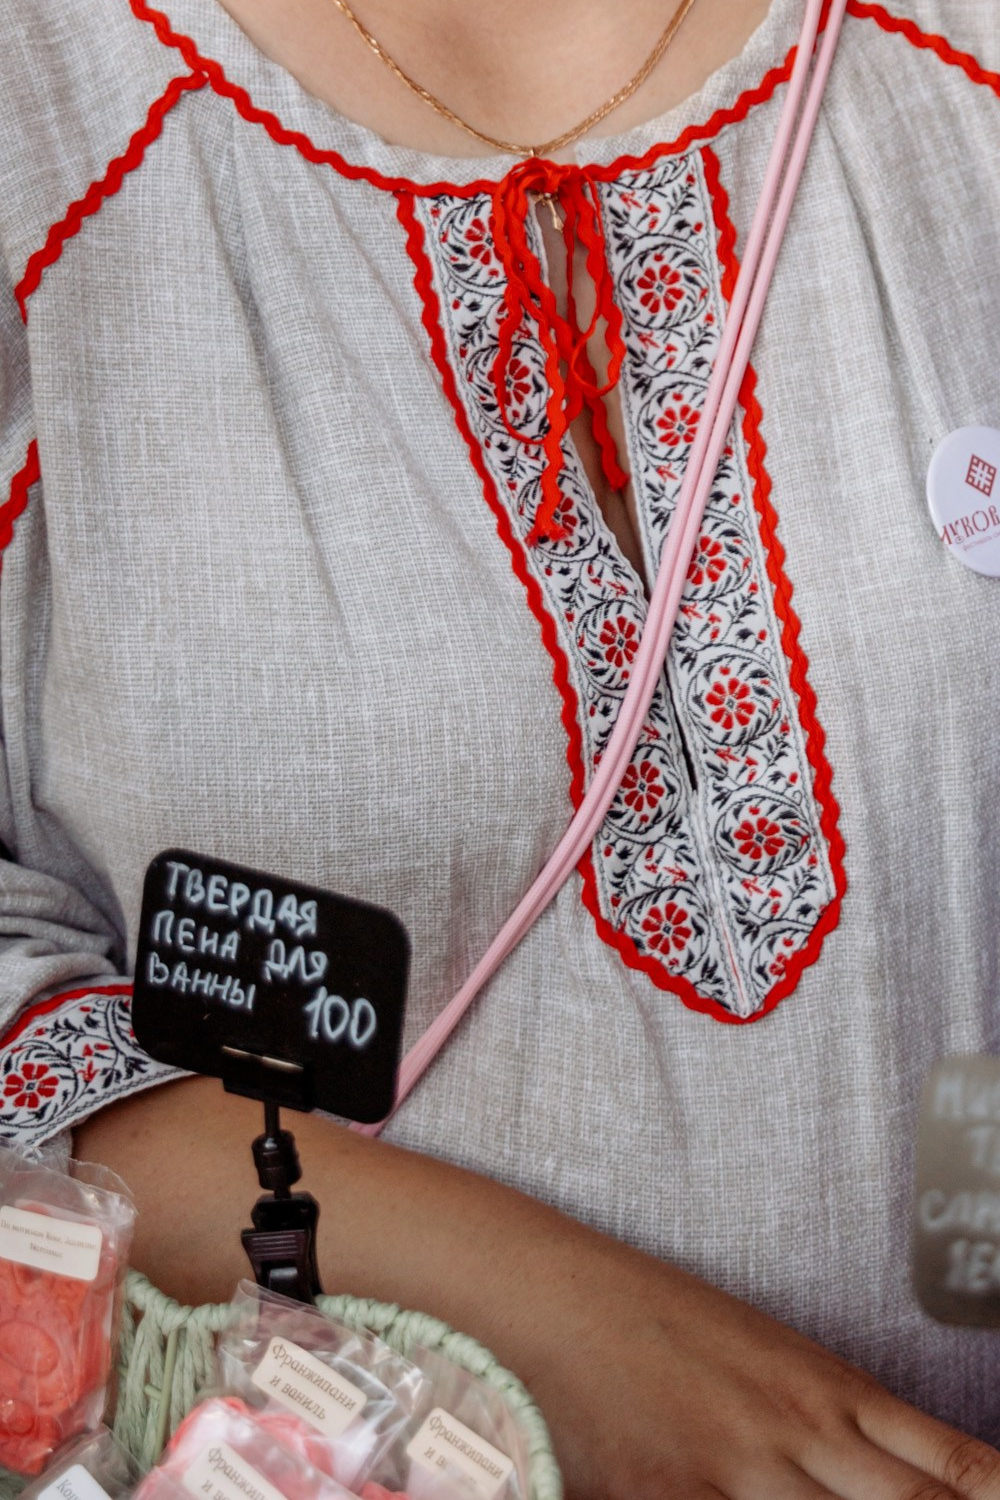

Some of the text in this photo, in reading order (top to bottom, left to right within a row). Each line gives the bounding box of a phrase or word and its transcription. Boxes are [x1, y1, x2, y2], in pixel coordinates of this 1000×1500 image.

[165, 860, 317, 936] ТВЕРДАЯ
[153, 910, 328, 982] ПЕНА ДЛЯ
[149, 952, 256, 1009] ВАННЫ
[305, 987, 377, 1046] 100
[270, 1375, 326, 1420] и ваниль
[272, 1343, 356, 1411] Франжипани
[429, 1415, 504, 1479] Франжипани
